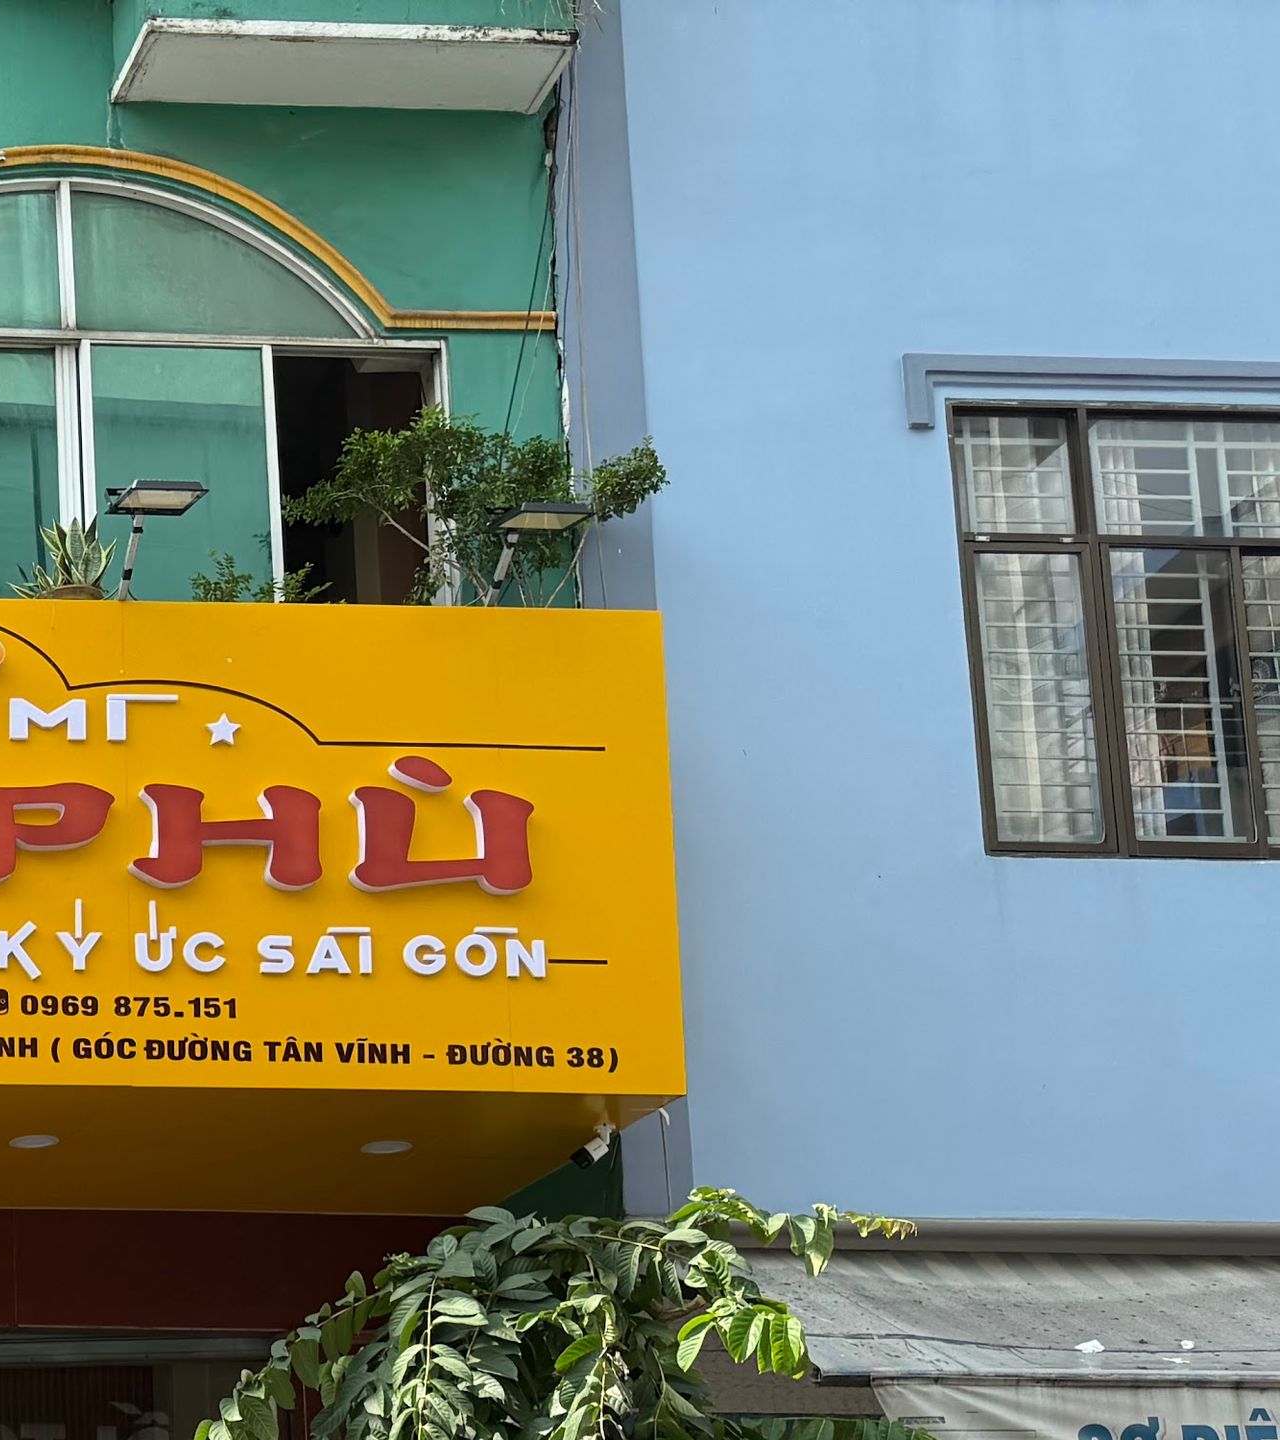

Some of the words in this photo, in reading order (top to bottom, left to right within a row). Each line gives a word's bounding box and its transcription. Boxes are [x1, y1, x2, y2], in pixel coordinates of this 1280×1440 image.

[21, 994, 99, 1016] 0969
[73, 1031, 136, 1060] GÓC
[144, 1032, 252, 1062] ĐƯỜNG
[264, 1037, 323, 1062] TÂN
[335, 1038, 411, 1064] VĨNH
[446, 1039, 555, 1067] ĐƯỜNG
